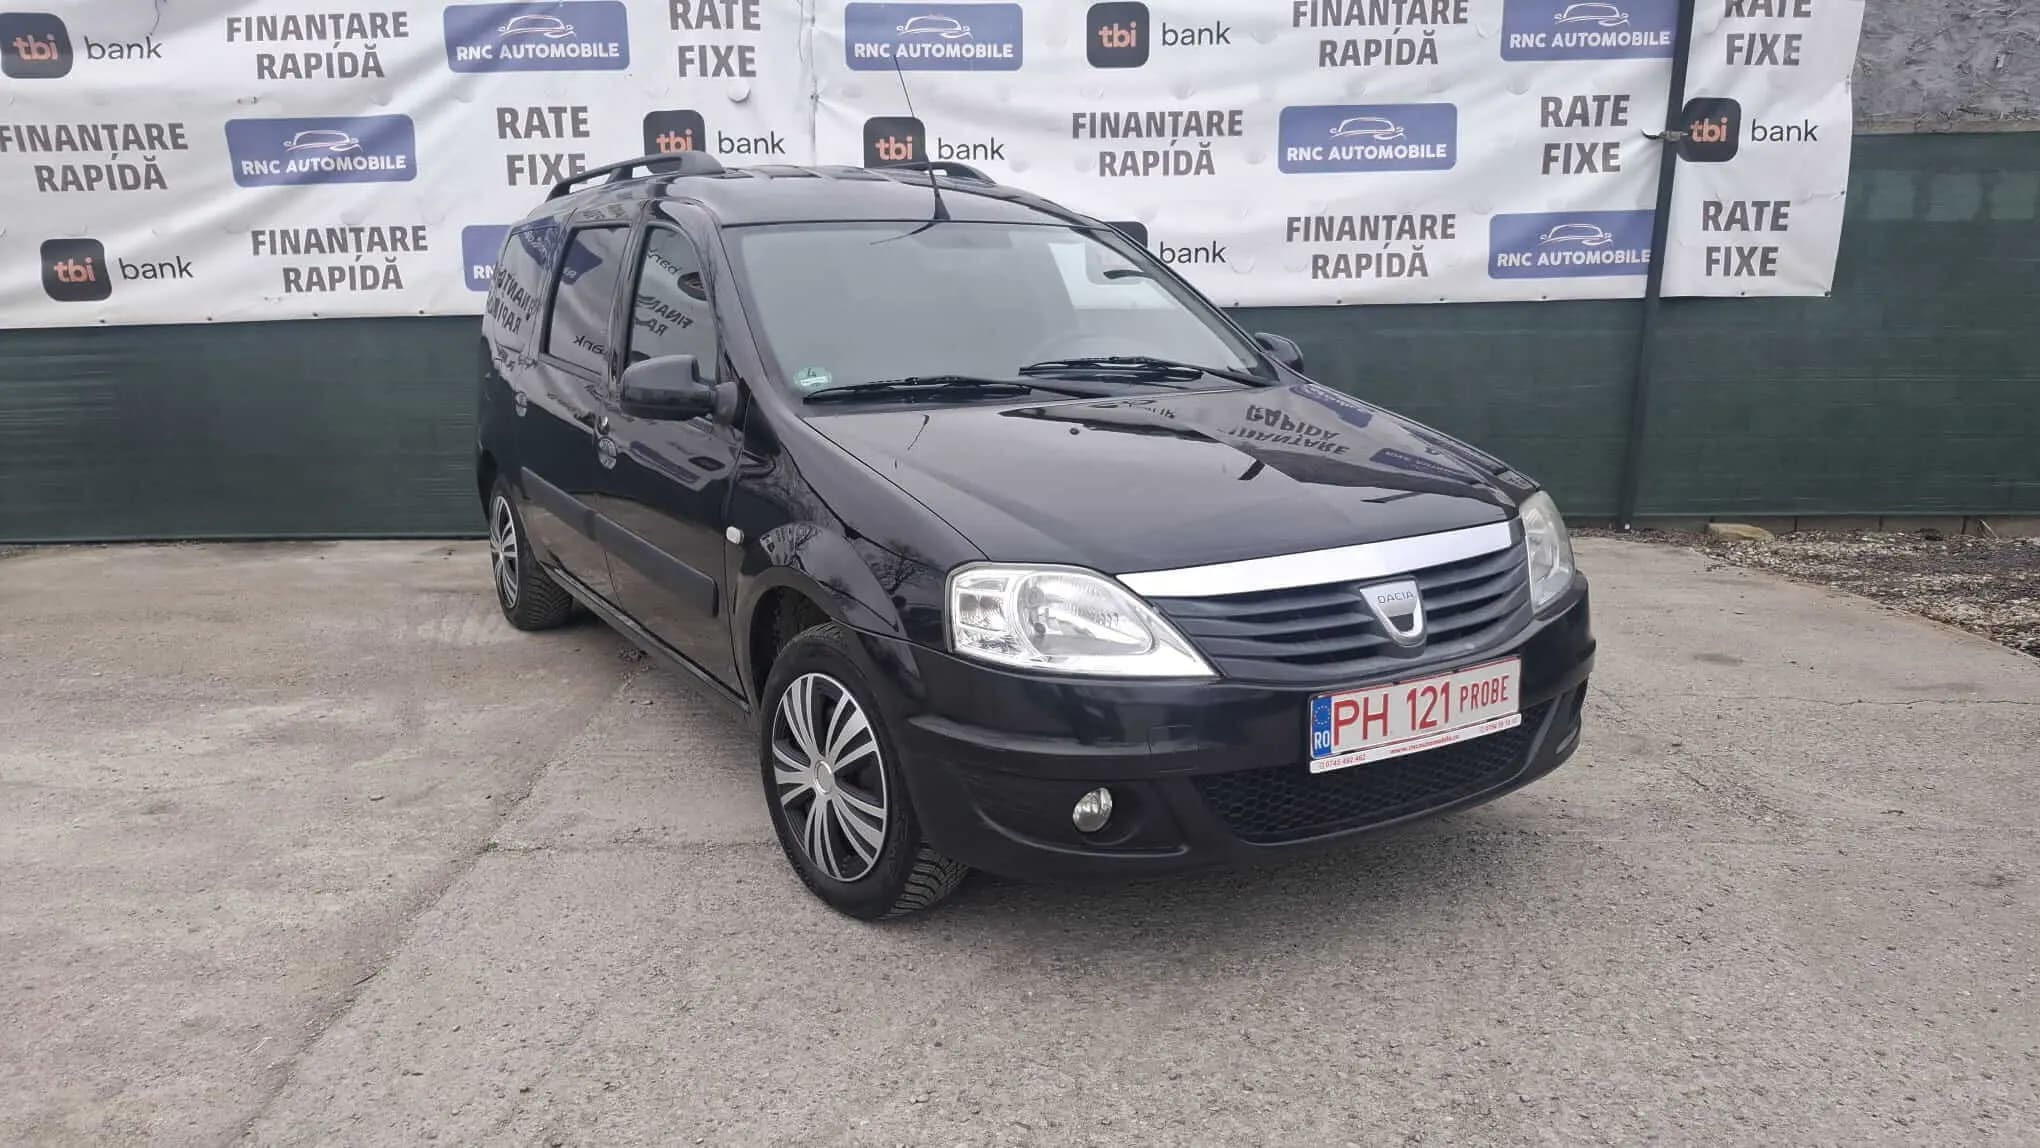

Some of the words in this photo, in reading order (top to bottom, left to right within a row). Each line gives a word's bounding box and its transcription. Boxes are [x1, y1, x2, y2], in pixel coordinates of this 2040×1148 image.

[669, 0, 760, 30] RATE
[1099, 22, 1136, 47] tbi
[1163, 21, 1230, 46] bank
[1510, 33, 1546, 48] RNC
[1552, 32, 1670, 47] AUTOMOBILE
[13, 35, 58, 60] tbi
[84, 35, 161, 59] bank
[457, 45, 492, 61] RNC
[500, 43, 619, 59] AUTOMOBILE
[855, 43, 890, 57] RNC
[896, 44, 1013, 58] AUTOMOBILE
[1727, 33, 1802, 66] FIXE
[678, 45, 756, 77] FIXE
[497, 106, 589, 139] RATE
[1541, 94, 1630, 127] RATE
[656, 129, 693, 153] tbi
[718, 131, 785, 154] bank
[1691, 117, 1727, 142] tbi
[1752, 119, 1818, 141] bank
[876, 136, 912, 160] tbi
[938, 137, 1004, 160] bank
[1288, 147, 1322, 161] RNC
[1328, 144, 1446, 160] AUTOMOBILE
[1542, 142, 1620, 175] FIXE
[242, 160, 280, 174] RNC
[286, 155, 406, 173] AUTOMOBILE
[506, 152, 586, 186] FIXE
[1703, 201, 1790, 231] RATE
[1160, 239, 1226, 264] bank
[1498, 253, 1532, 266] RNC
[1537, 250, 1650, 266] AUTOMOBILE
[1706, 246, 1778, 276] FIXE
[54, 258, 95, 282] tbi
[119, 256, 193, 280] bank
[473, 264, 495, 280] RN
[1377, 591, 1415, 604] DACIA
[1333, 694, 1389, 746] PH
[1406, 681, 1451, 731] 121
[1459, 675, 1510, 713] PROBE
[1314, 731, 1331, 750] RO
